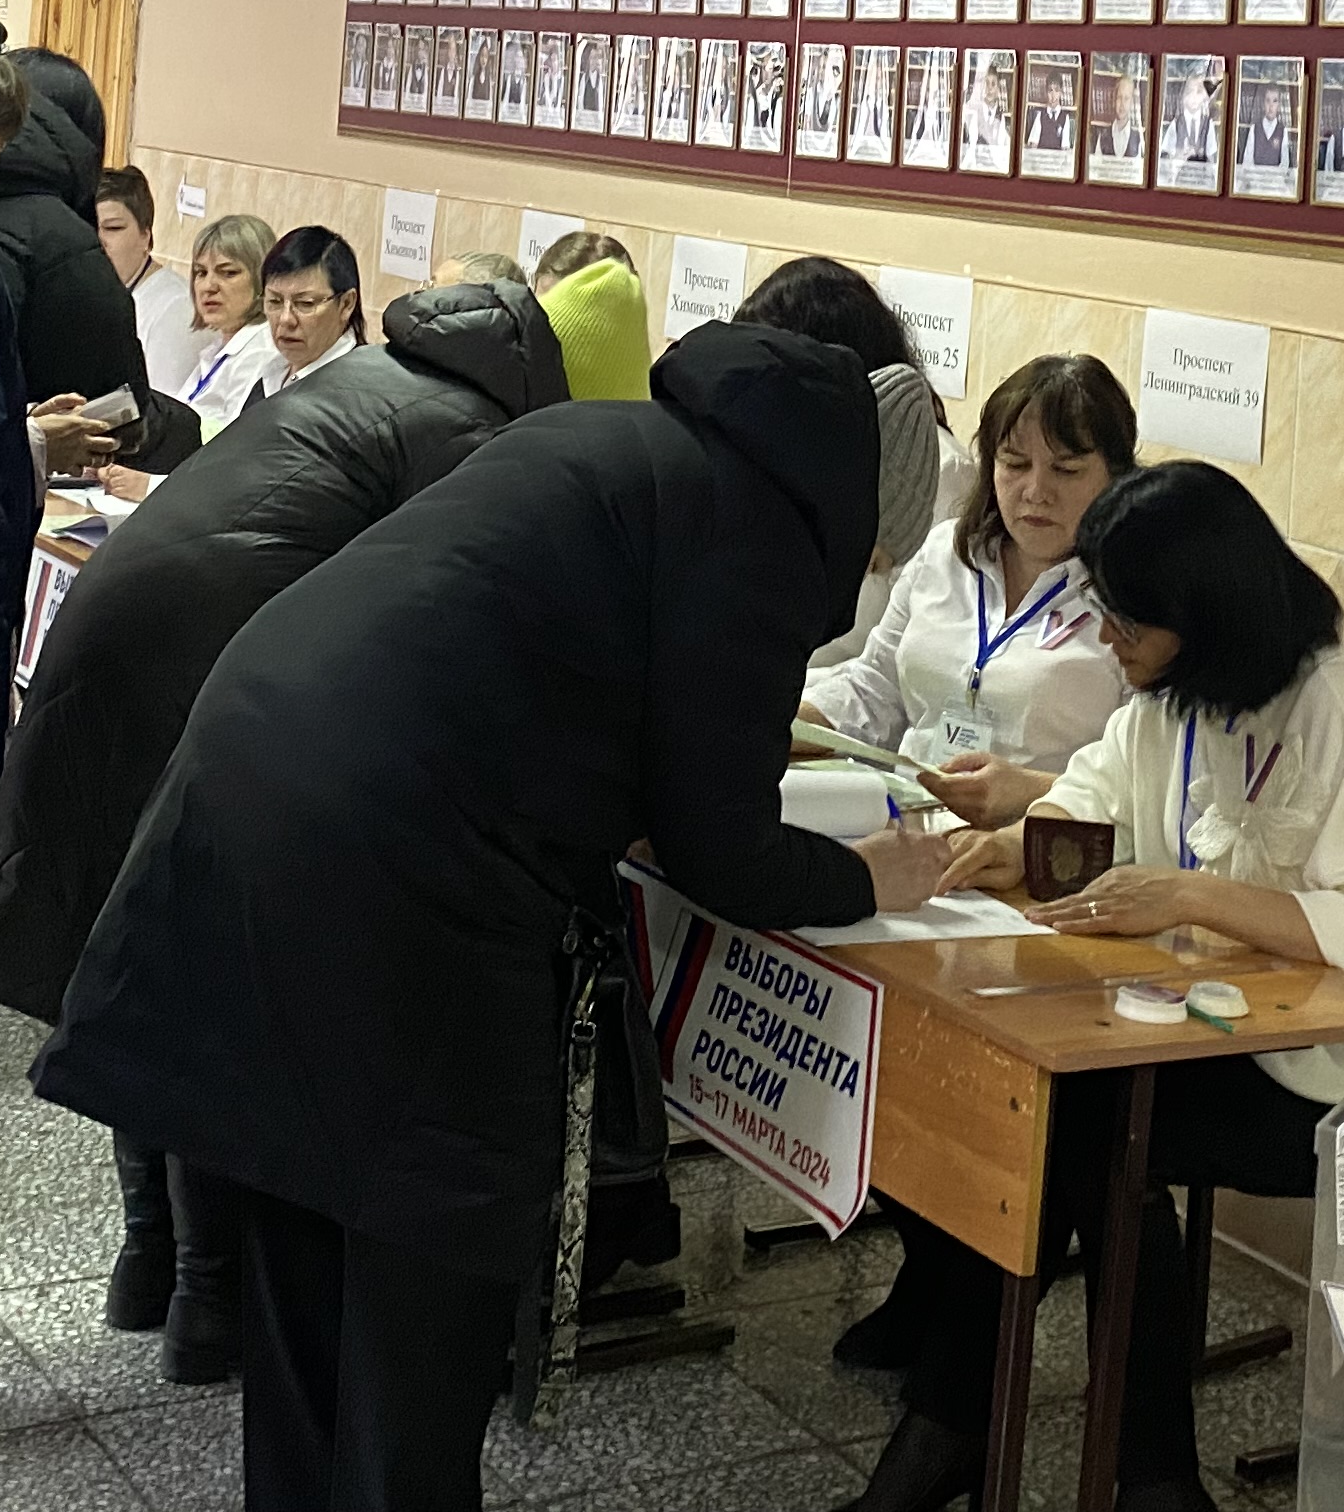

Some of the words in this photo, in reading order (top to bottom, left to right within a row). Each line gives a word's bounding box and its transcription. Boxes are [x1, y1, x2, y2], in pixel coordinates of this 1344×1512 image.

[684, 266, 730, 292] Проспект
[670, 293, 715, 318] Химиков
[942, 346, 959, 369] 25
[1172, 347, 1234, 375] Проспект
[1144, 370, 1241, 406] Ленинградский
[1243, 389, 1259, 409] 39
[724, 935, 833, 1022] ВЫБОРЫ
[707, 983, 861, 1099] ПРЕЗИДЕНТА
[691, 1029, 789, 1112] РОССИИ
[732, 1106, 787, 1164] МАРТА
[789, 1138, 831, 1190] 2024
